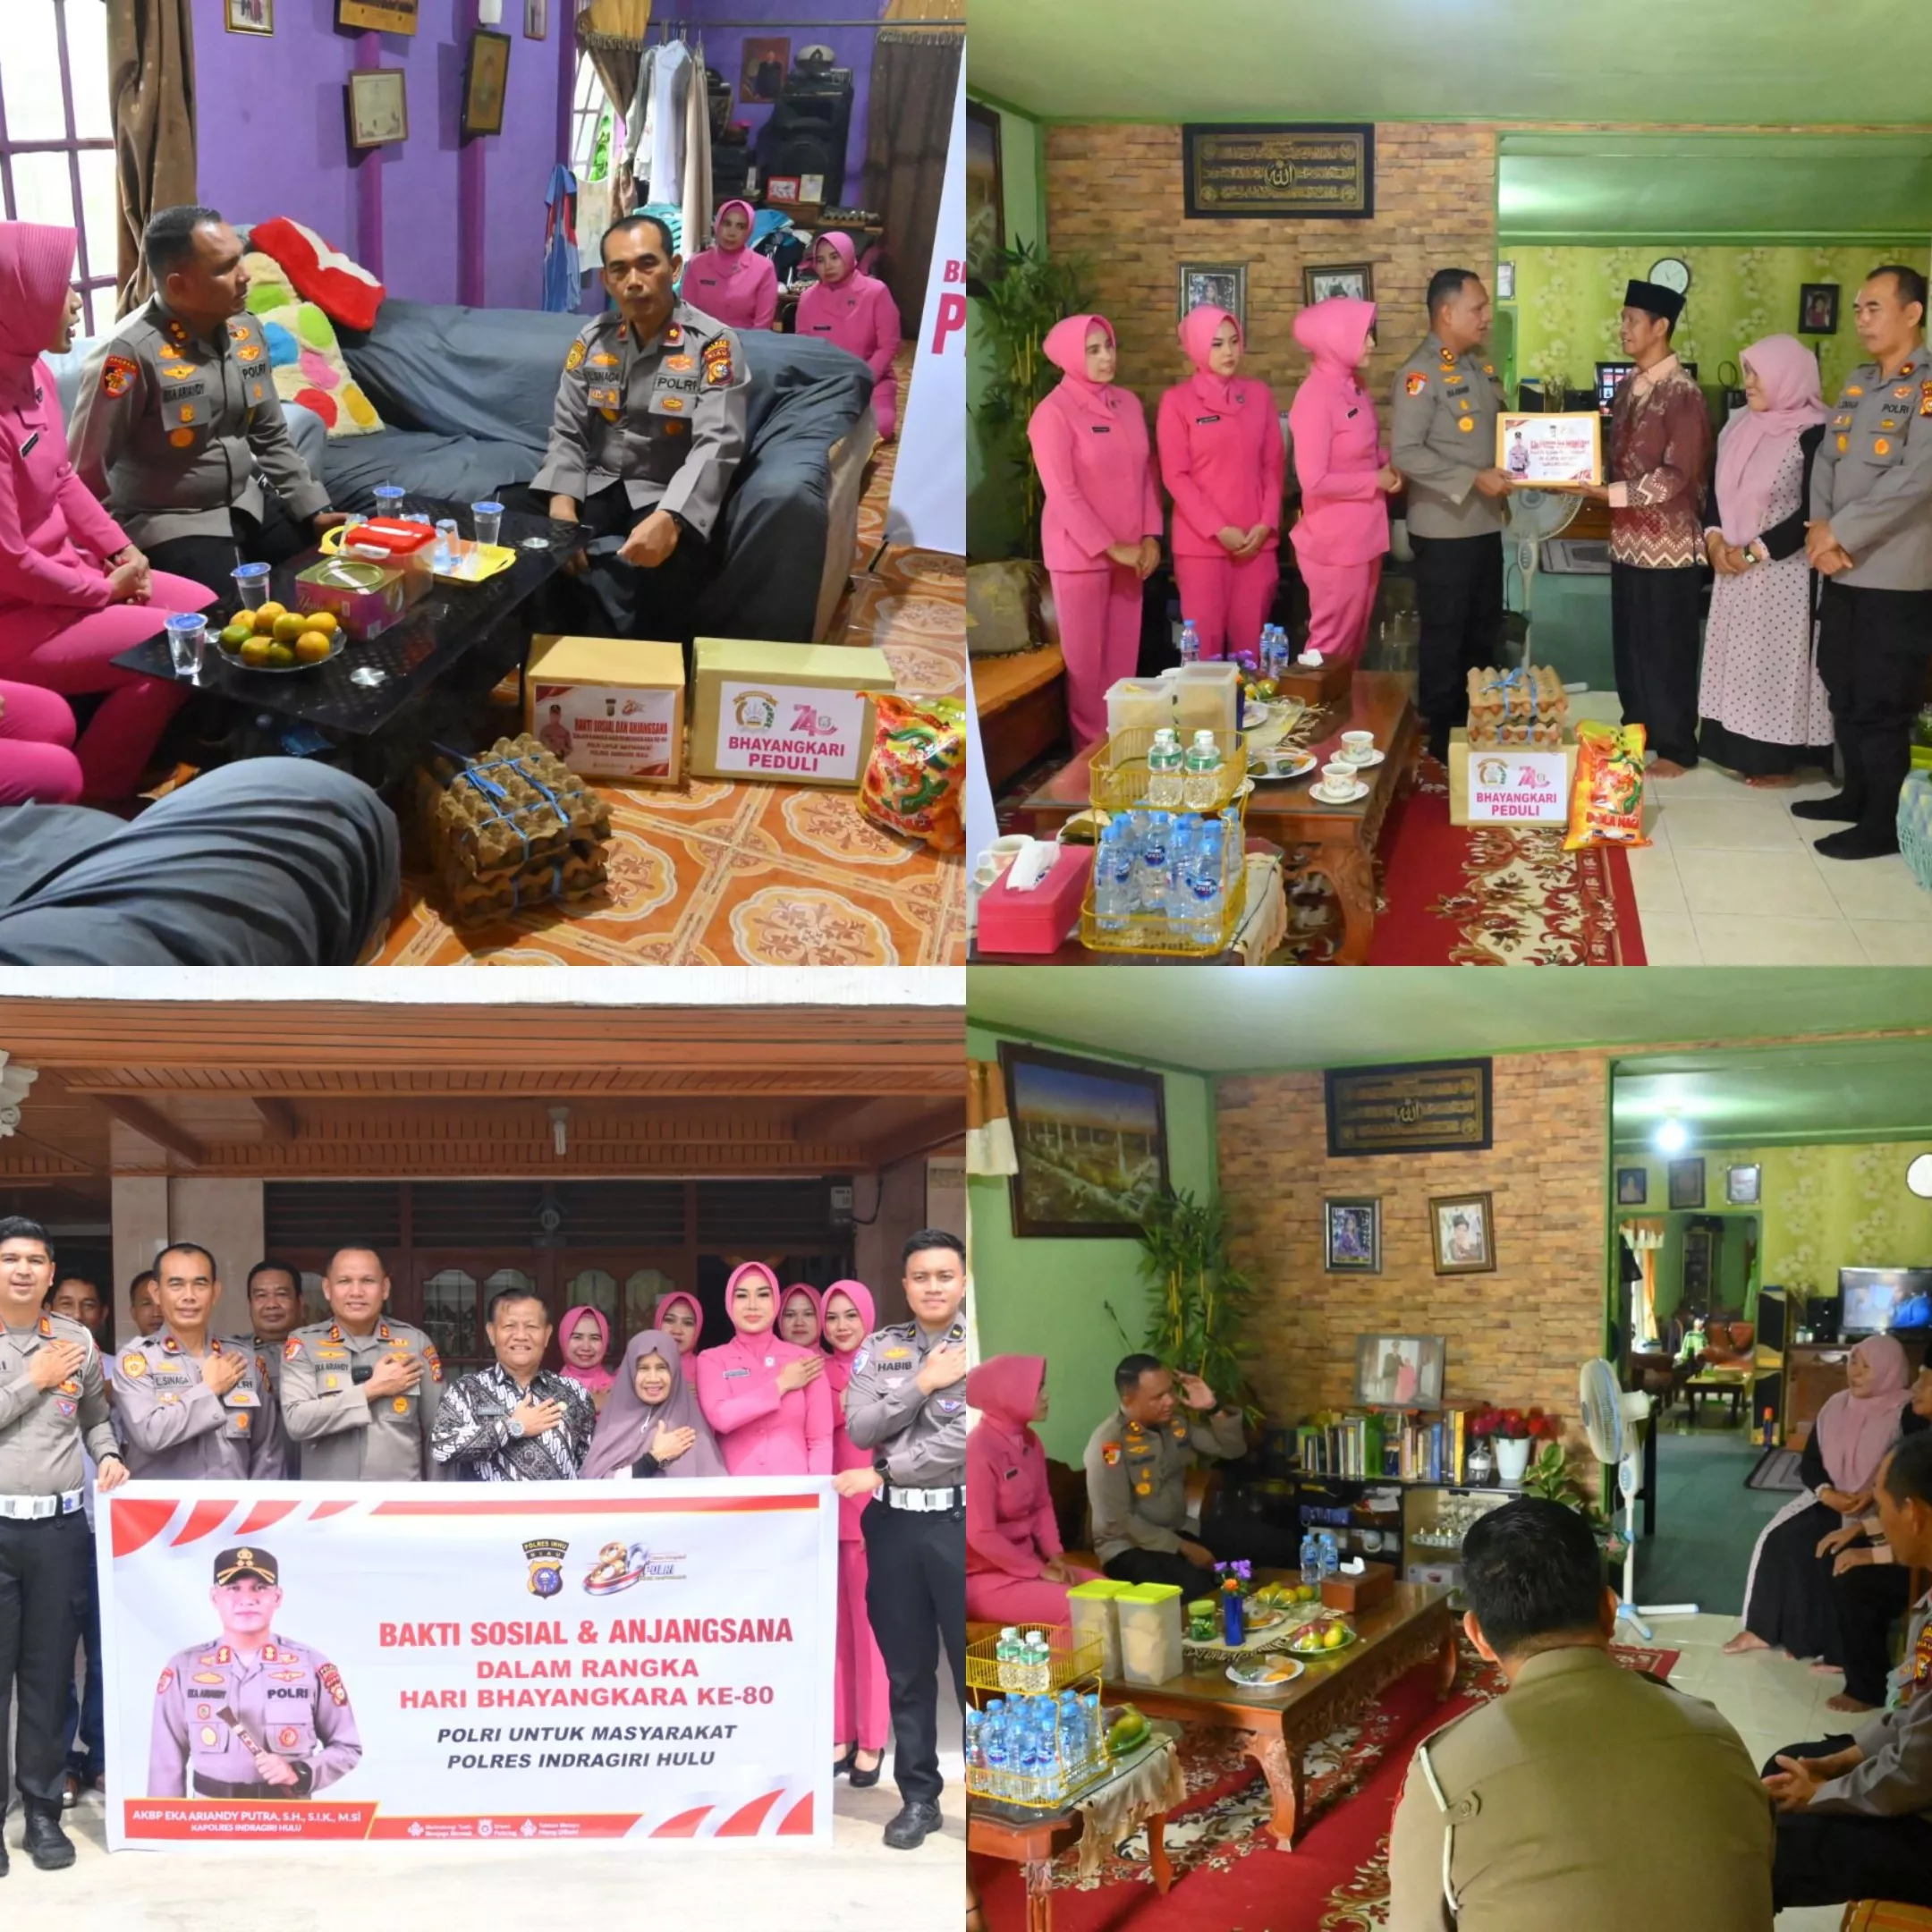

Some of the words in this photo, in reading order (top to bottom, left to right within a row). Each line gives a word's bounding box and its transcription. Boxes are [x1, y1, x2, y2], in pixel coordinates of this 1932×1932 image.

[242, 363, 266, 379] POLRI
[657, 377, 698, 391] POLRI
[1882, 403, 1910, 414] POLRI
[729, 736, 845, 757] BHAYANGKARI
[749, 753, 818, 772] PEDULI
[1476, 792, 1557, 803] BHAYANGKARI
[1491, 805, 1539, 816] PEDULI
[877, 1361, 912, 1372] HABIB
[156, 1376, 189, 1386] L.SINAGA
[379, 1623, 461, 1647] BAKTI
[470, 1621, 568, 1646] SOSIAL
[577, 1620, 598, 1644] &
[608, 1618, 793, 1644] ANJANGSANA
[477, 1659, 571, 1679] DALAM
[581, 1659, 699, 1678] RANGKA
[267, 1688, 309, 1699] POLRI
[400, 1690, 467, 1708] HARI
[478, 1687, 688, 1707] BHAYANGKARA
[698, 1686, 774, 1706] KE-80
[436, 1727, 502, 1743] POLRI
[508, 1727, 585, 1741] UNTUK
[590, 1724, 738, 1741] MASYARAKAT
[447, 1753, 532, 1769] POLRES
[538, 1752, 650, 1767] INDRAGIRI
[657, 1751, 716, 1767] HULU
[132, 1810, 163, 1820] AKBP
[165, 1810, 187, 1821] EKA
[188, 1810, 239, 1821] ARIANDY
[191, 1824, 233, 1832] KAPOLRES
[234, 1824, 277, 1832] INDRAGIRI
[279, 1824, 301, 1832] HULU
